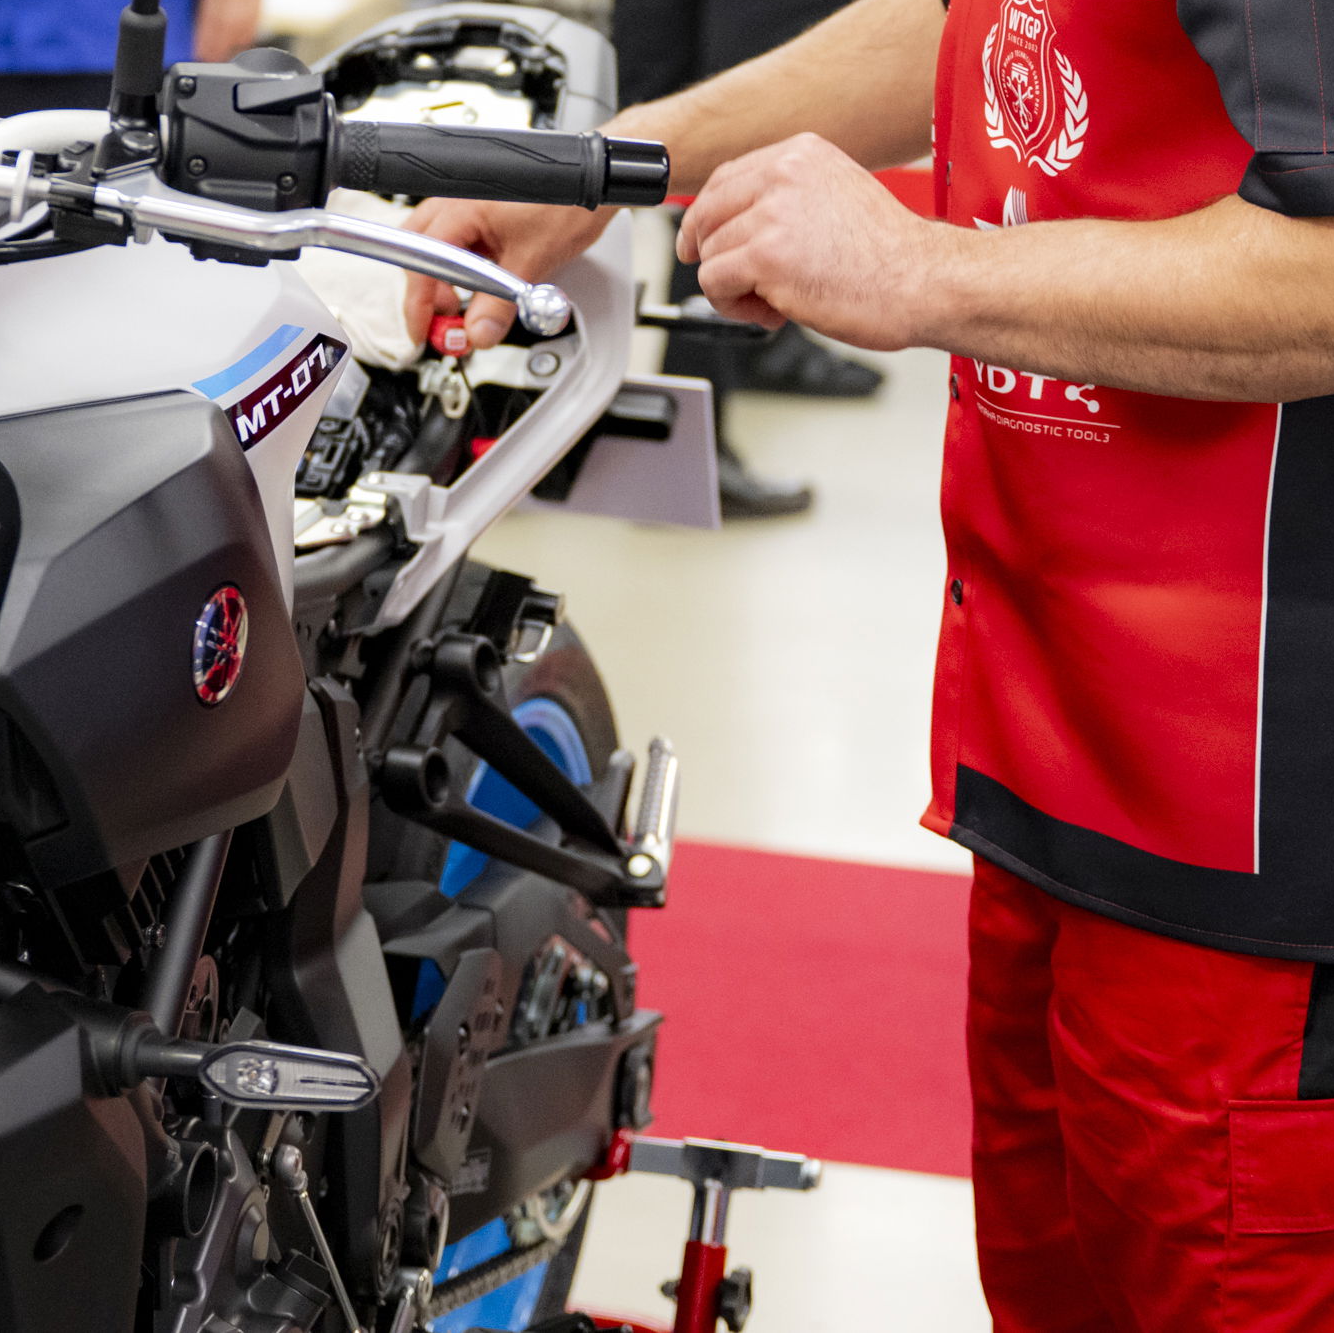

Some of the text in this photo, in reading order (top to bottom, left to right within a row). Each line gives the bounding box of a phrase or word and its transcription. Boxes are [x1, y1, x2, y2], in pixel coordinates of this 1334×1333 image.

[1009, 7, 1041, 40] WTGP
[1008, 33, 1038, 53] SINCE 2002
[236, 343, 327, 442] MT-07
[973, 358, 1057, 400] YDT
[996, 417, 1063, 437] DIAGNOSTIC
